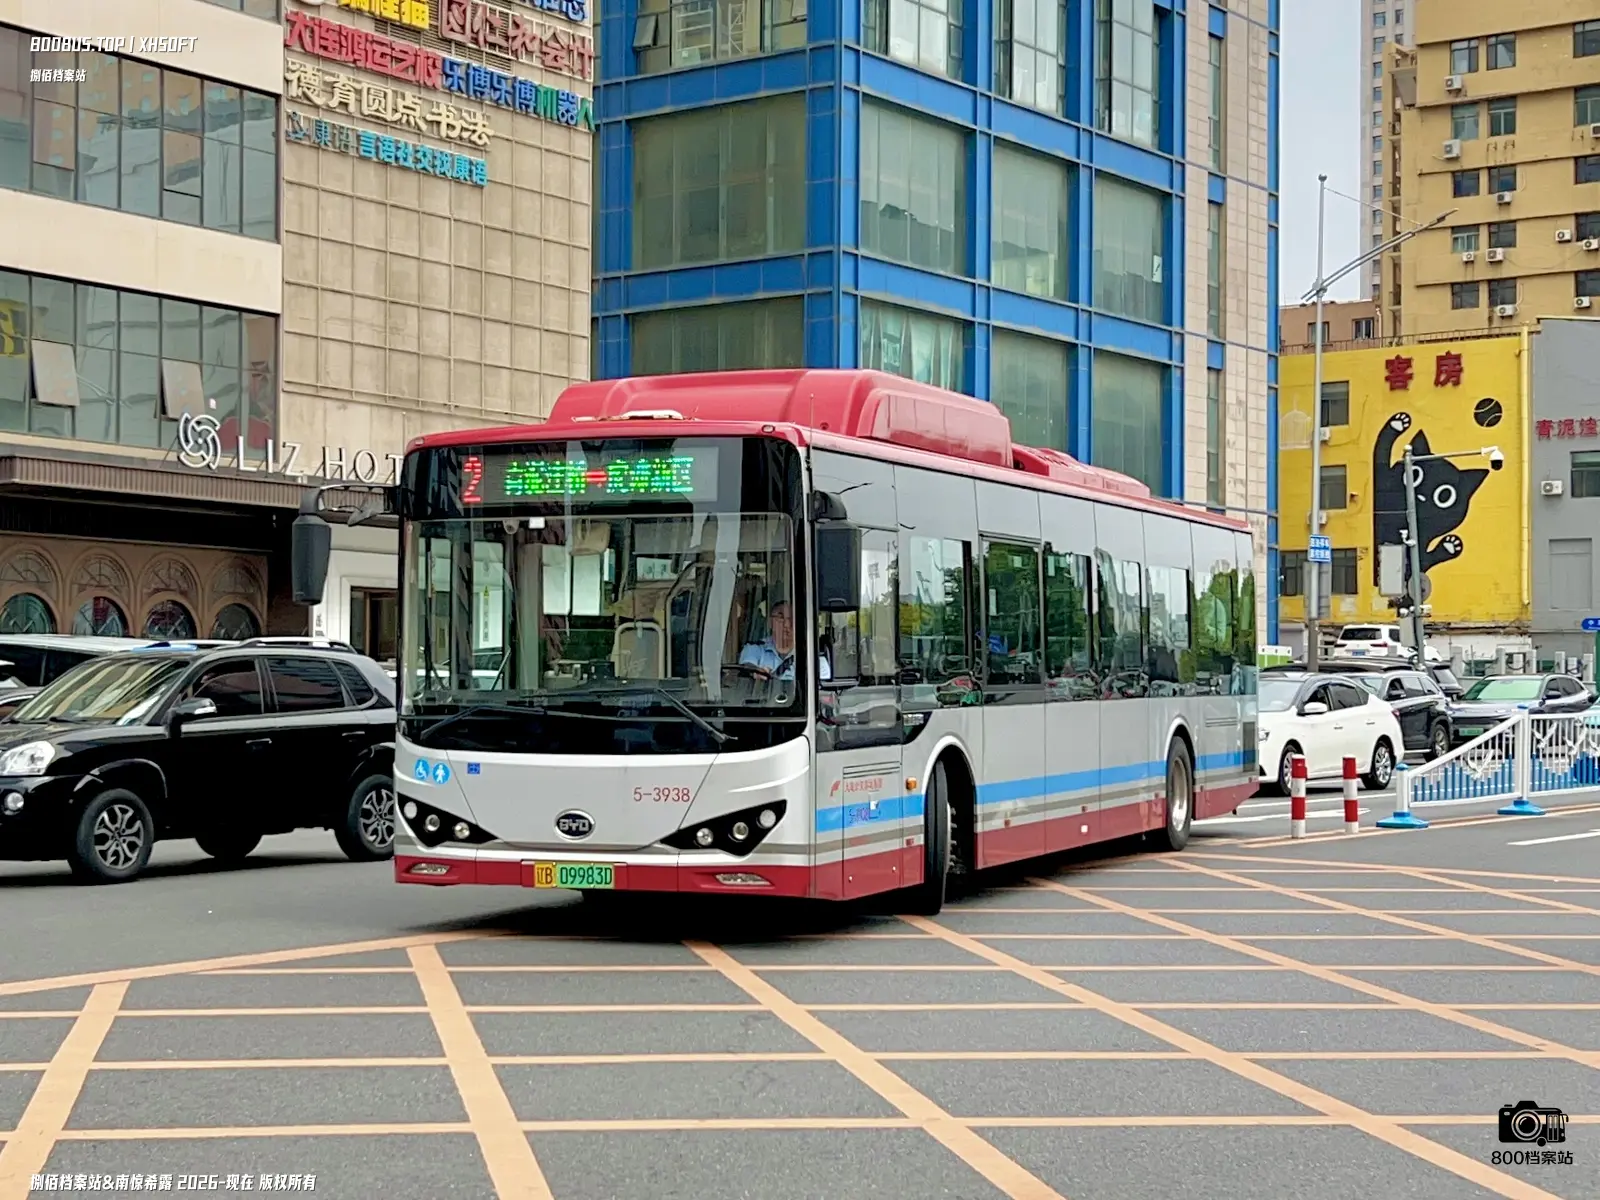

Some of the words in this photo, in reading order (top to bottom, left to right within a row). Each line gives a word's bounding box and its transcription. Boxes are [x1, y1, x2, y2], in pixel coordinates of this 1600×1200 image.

[284, 10, 442, 90] 大连鸿运艺校
[285, 59, 495, 145] 德育圆点书法
[442, 57, 595, 132] 乐博乐博机器人
[1384, 350, 1464, 391] 客房
[236, 435, 304, 477] LIZ
[463, 456, 483, 504] 2
[633, 787, 691, 803] 5-3938
[559, 818, 590, 832] BYD
